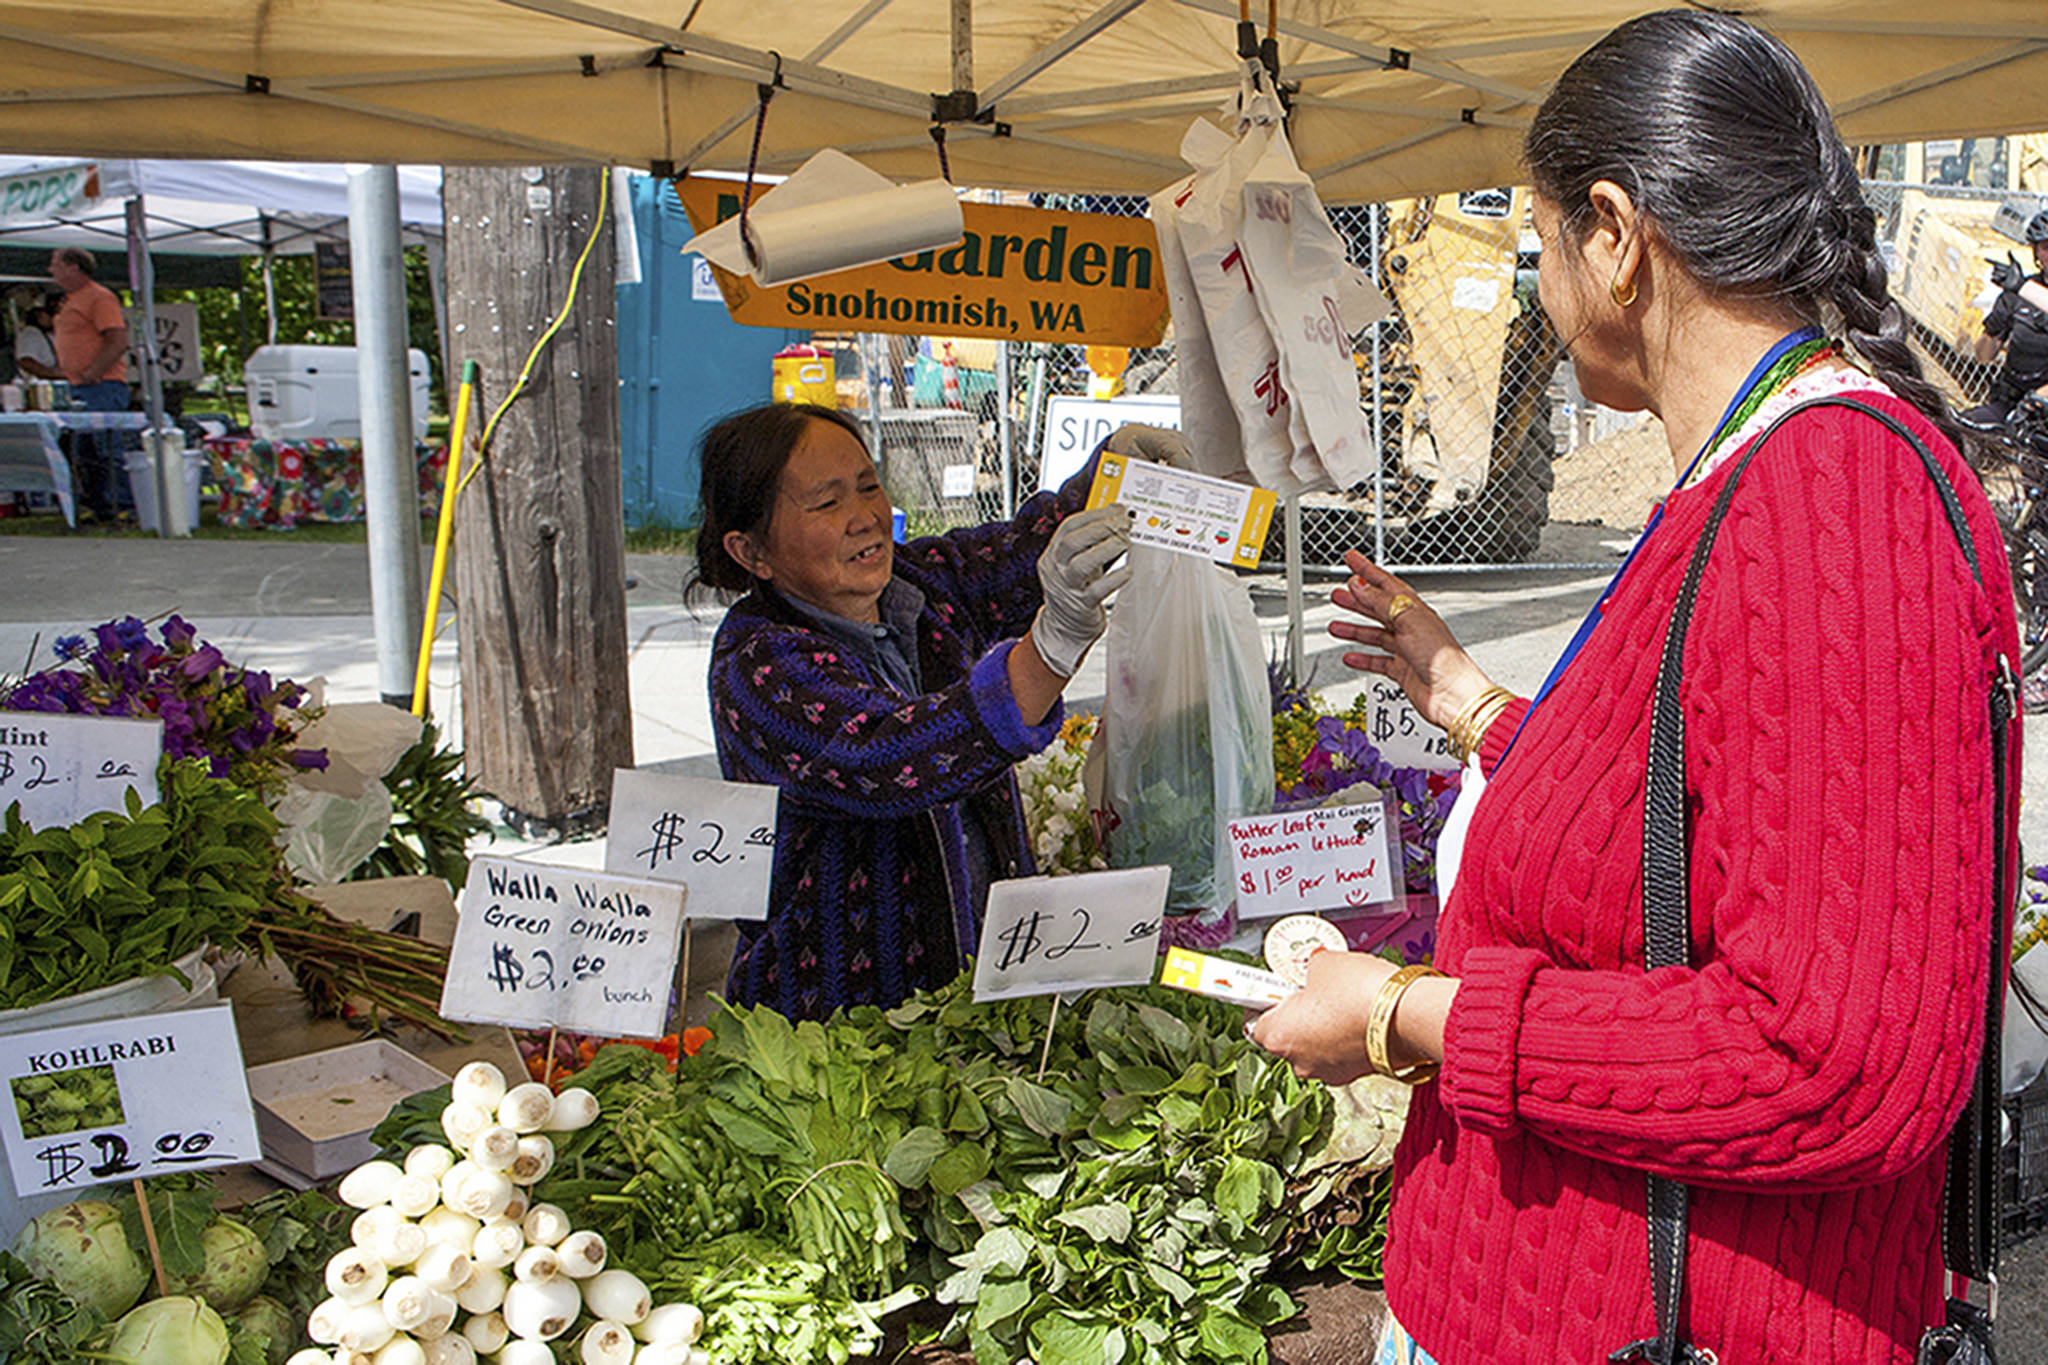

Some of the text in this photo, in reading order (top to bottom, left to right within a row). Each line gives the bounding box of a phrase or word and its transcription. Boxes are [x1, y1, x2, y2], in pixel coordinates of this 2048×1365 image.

[1, 172, 77, 215] POPS
[786, 283, 1085, 334] Snohomish, WA
[0, 726, 49, 747] int
[1338, 805, 1381, 819] Garden
[1228, 822, 1279, 840] Butter
[1240, 842, 1300, 860] Roman
[487, 866, 652, 919] Walla Walla
[1298, 873, 1325, 898] per
[484, 904, 551, 935] Green
[603, 986, 653, 1004] bunch
[28, 1035, 177, 1073] KOHLRABI
